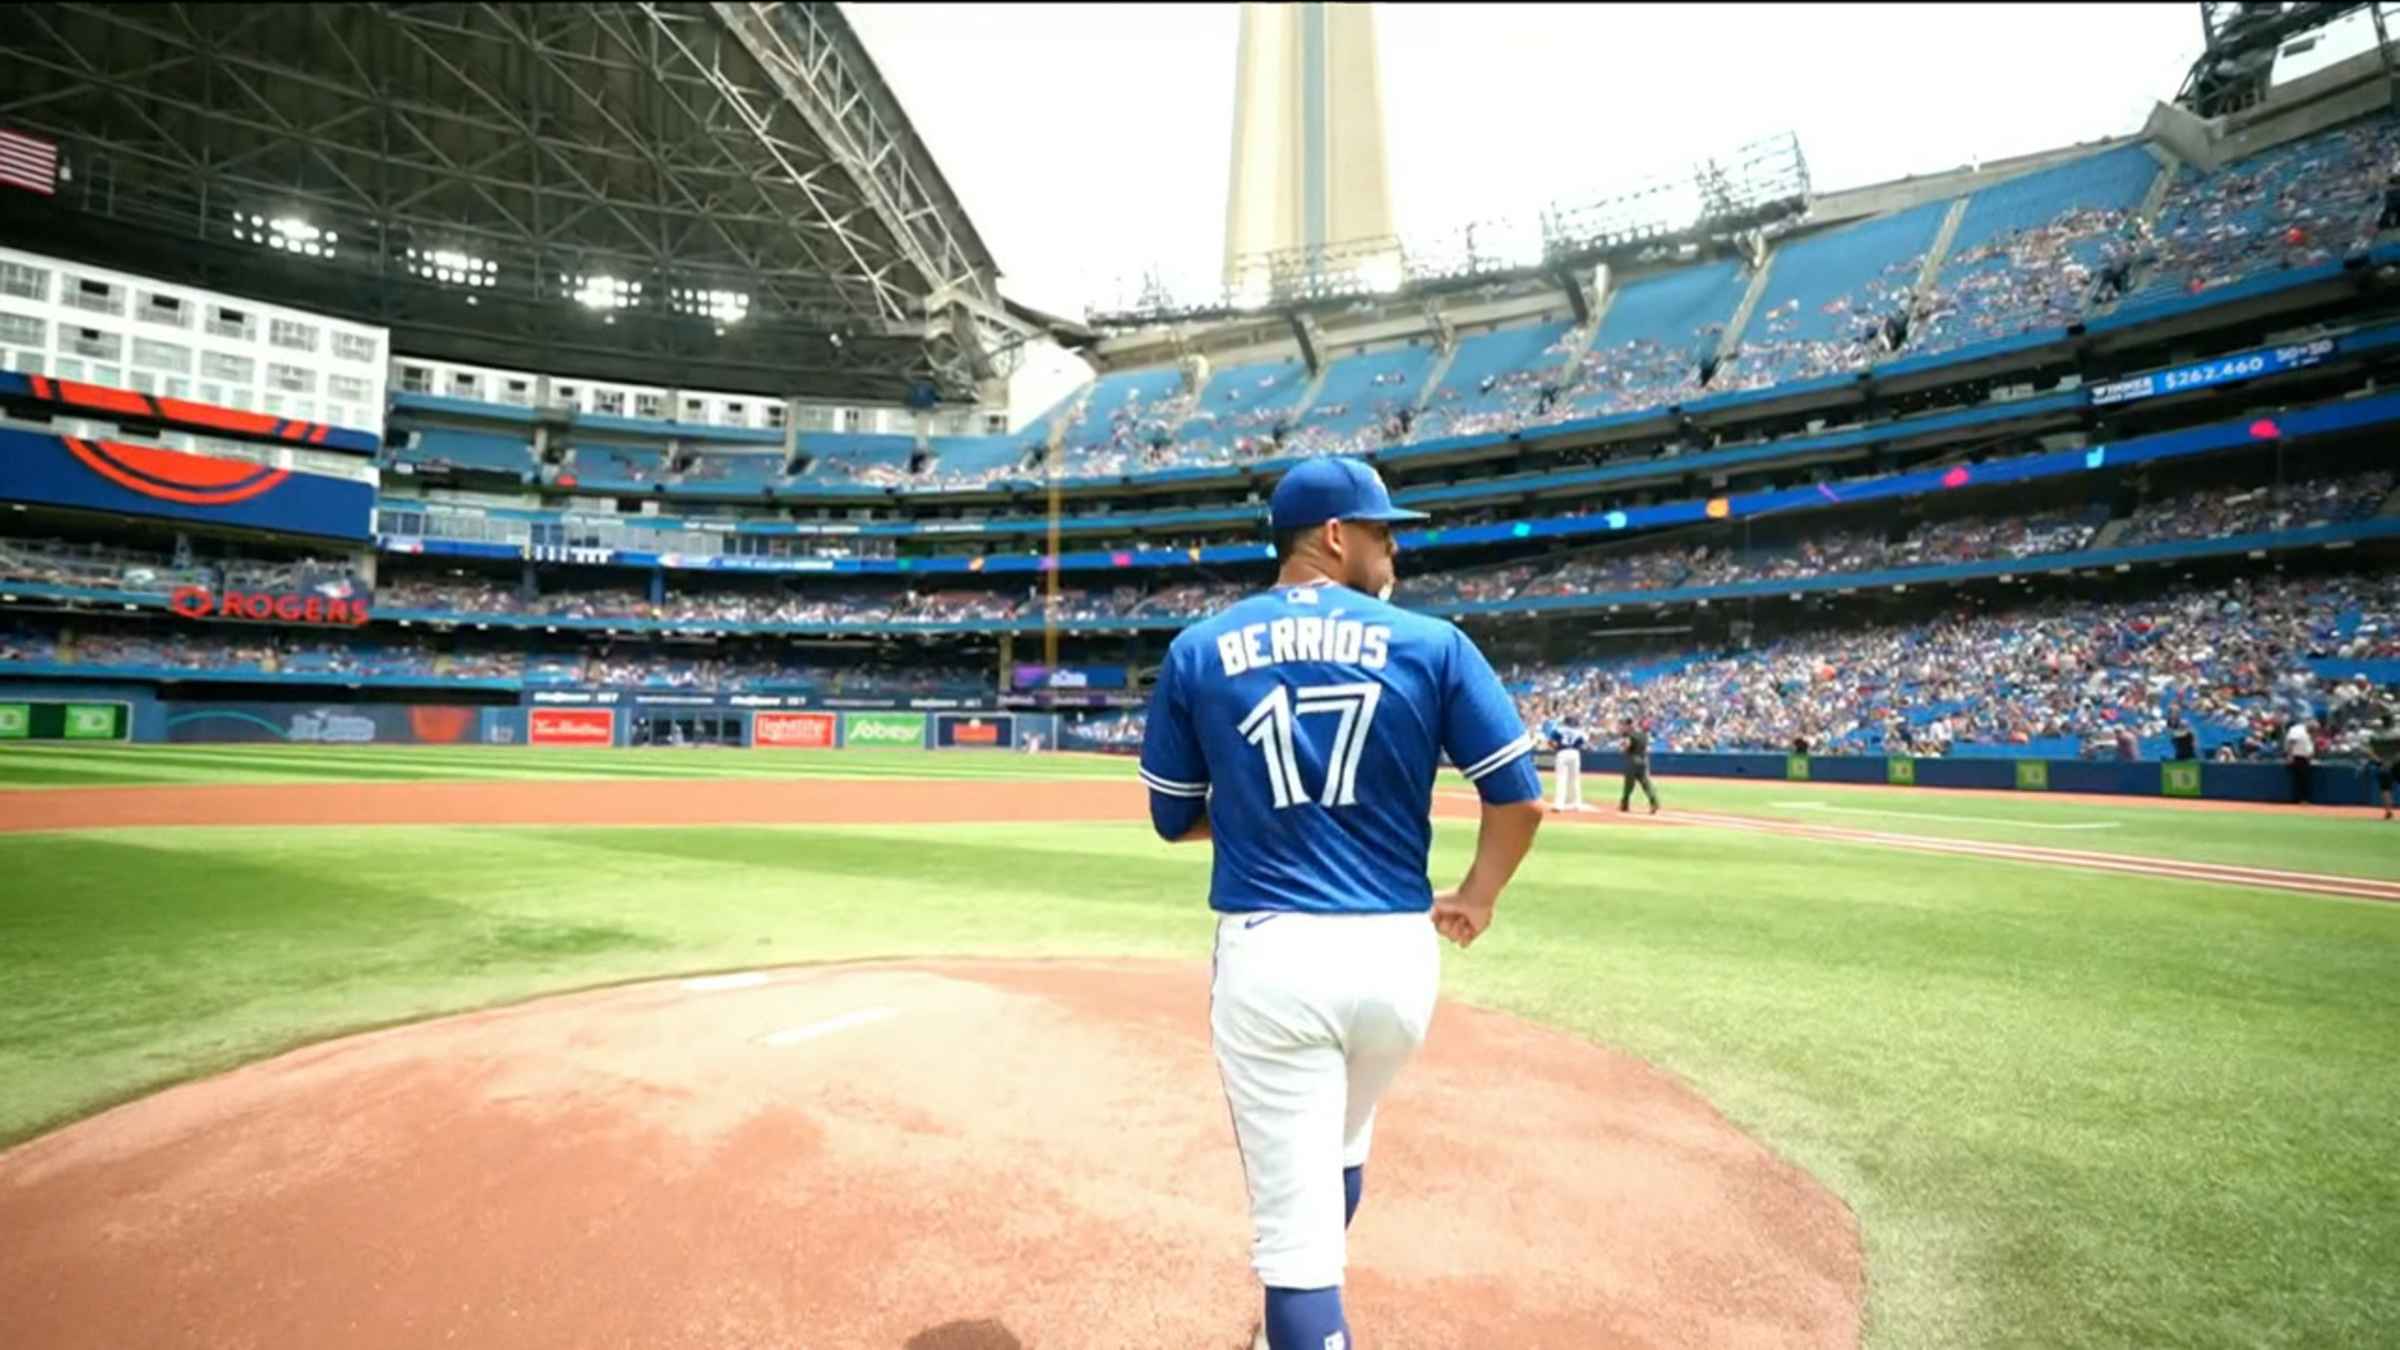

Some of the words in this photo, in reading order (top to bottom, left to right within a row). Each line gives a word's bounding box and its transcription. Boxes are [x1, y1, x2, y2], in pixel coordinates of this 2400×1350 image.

[221, 592, 369, 625] ROGERS
[1217, 608, 1391, 676] BERRÍOS
[1237, 681, 1382, 809] 17
